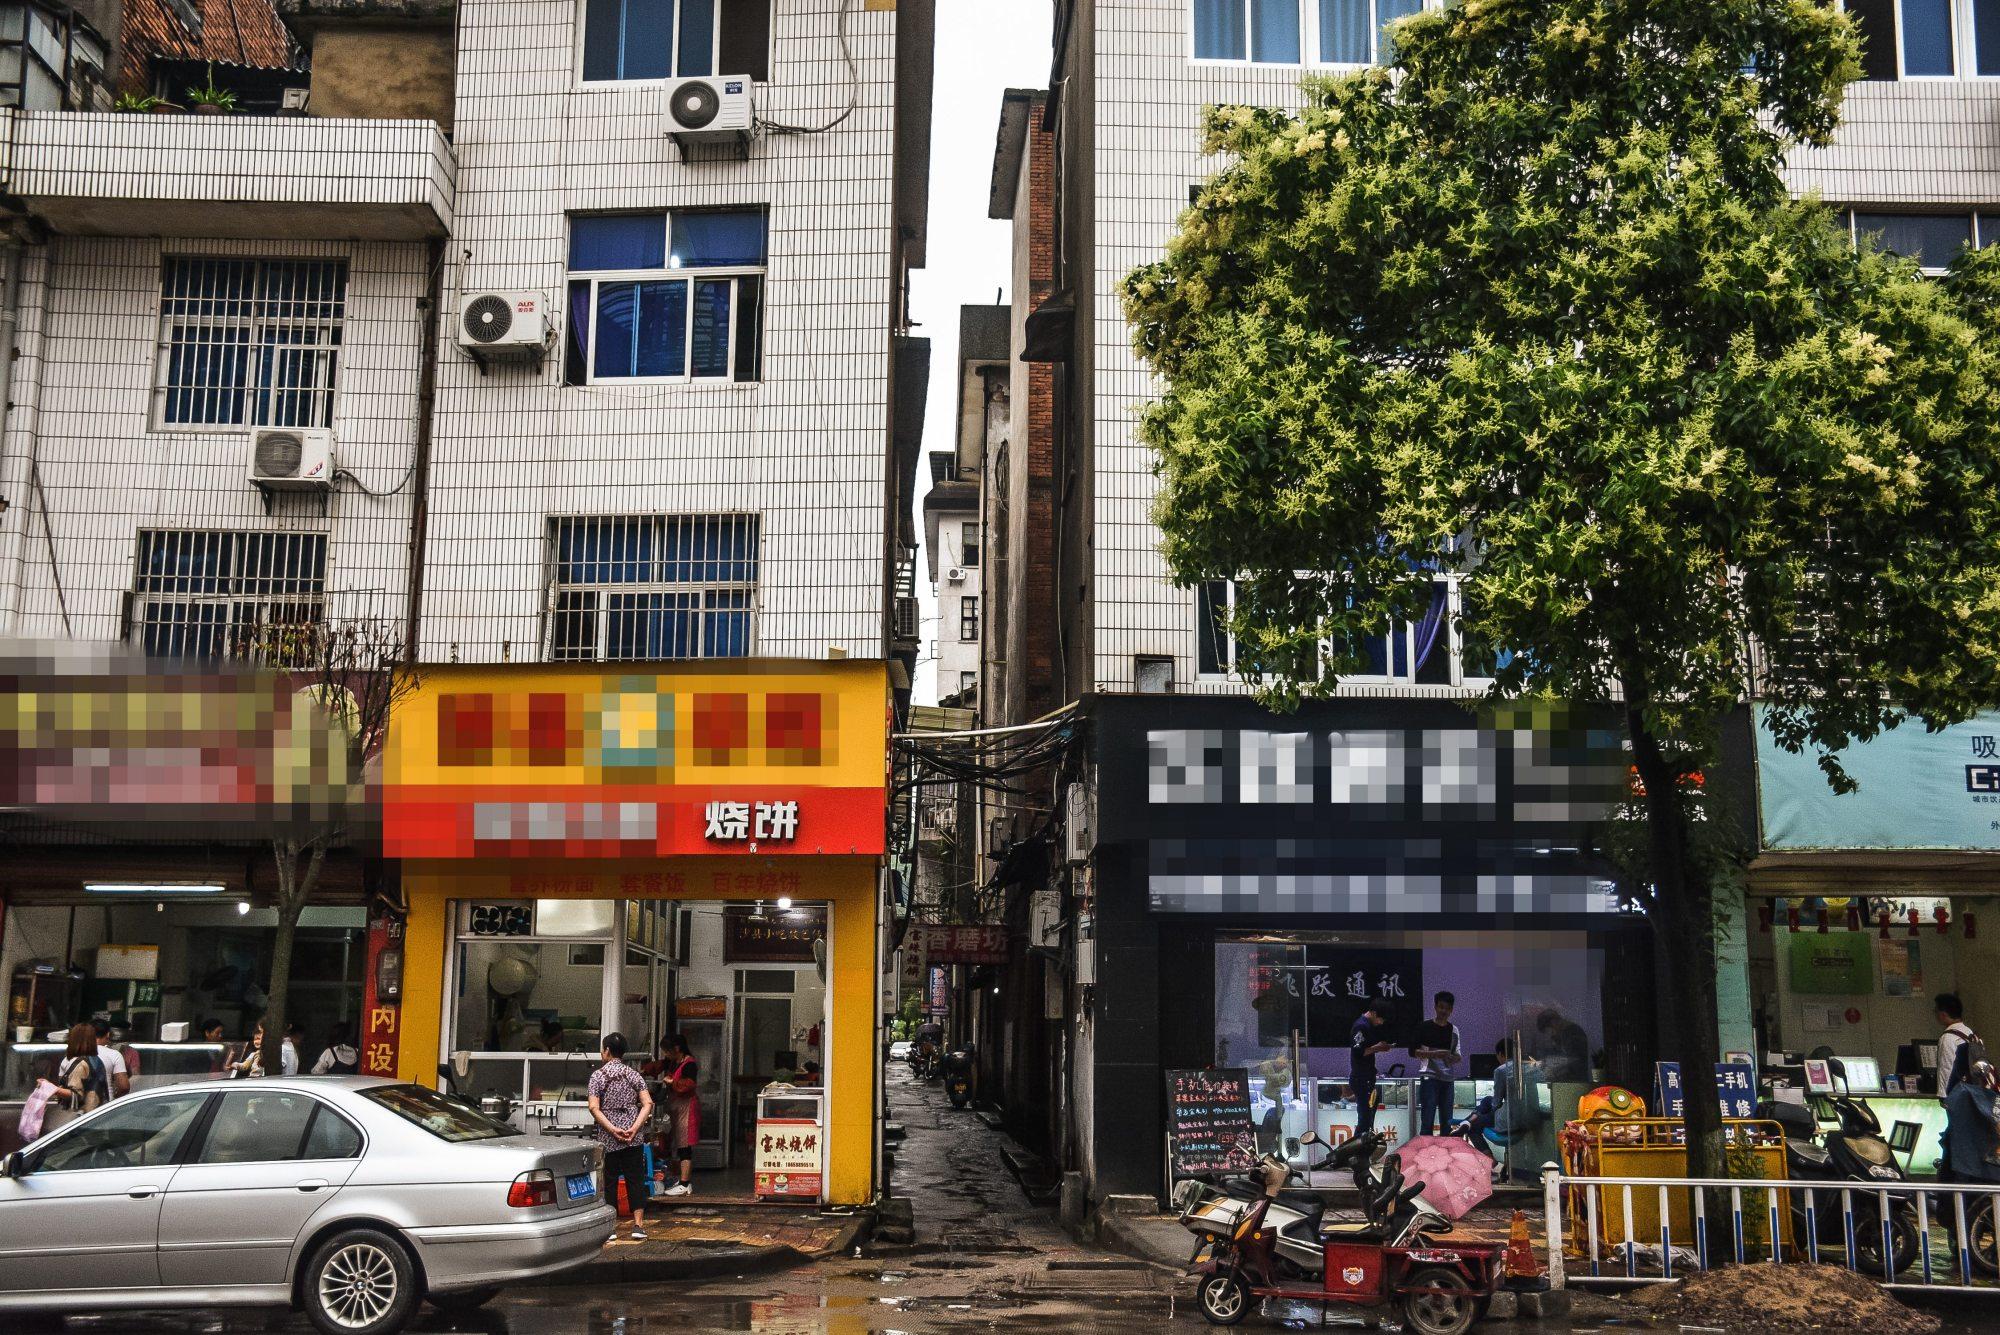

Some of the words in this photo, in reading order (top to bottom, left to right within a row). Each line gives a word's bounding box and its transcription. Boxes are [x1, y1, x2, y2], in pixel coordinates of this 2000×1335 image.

[1971, 735, 2000, 758] 吸
[1972, 795, 2000, 803] 城市饮
[704, 800, 799, 840] 烧饼
[711, 871, 801, 894] 百年烧饼
[1275, 971, 1405, 998] 飞跃通讯
[367, 1006, 396, 1072] 内设
